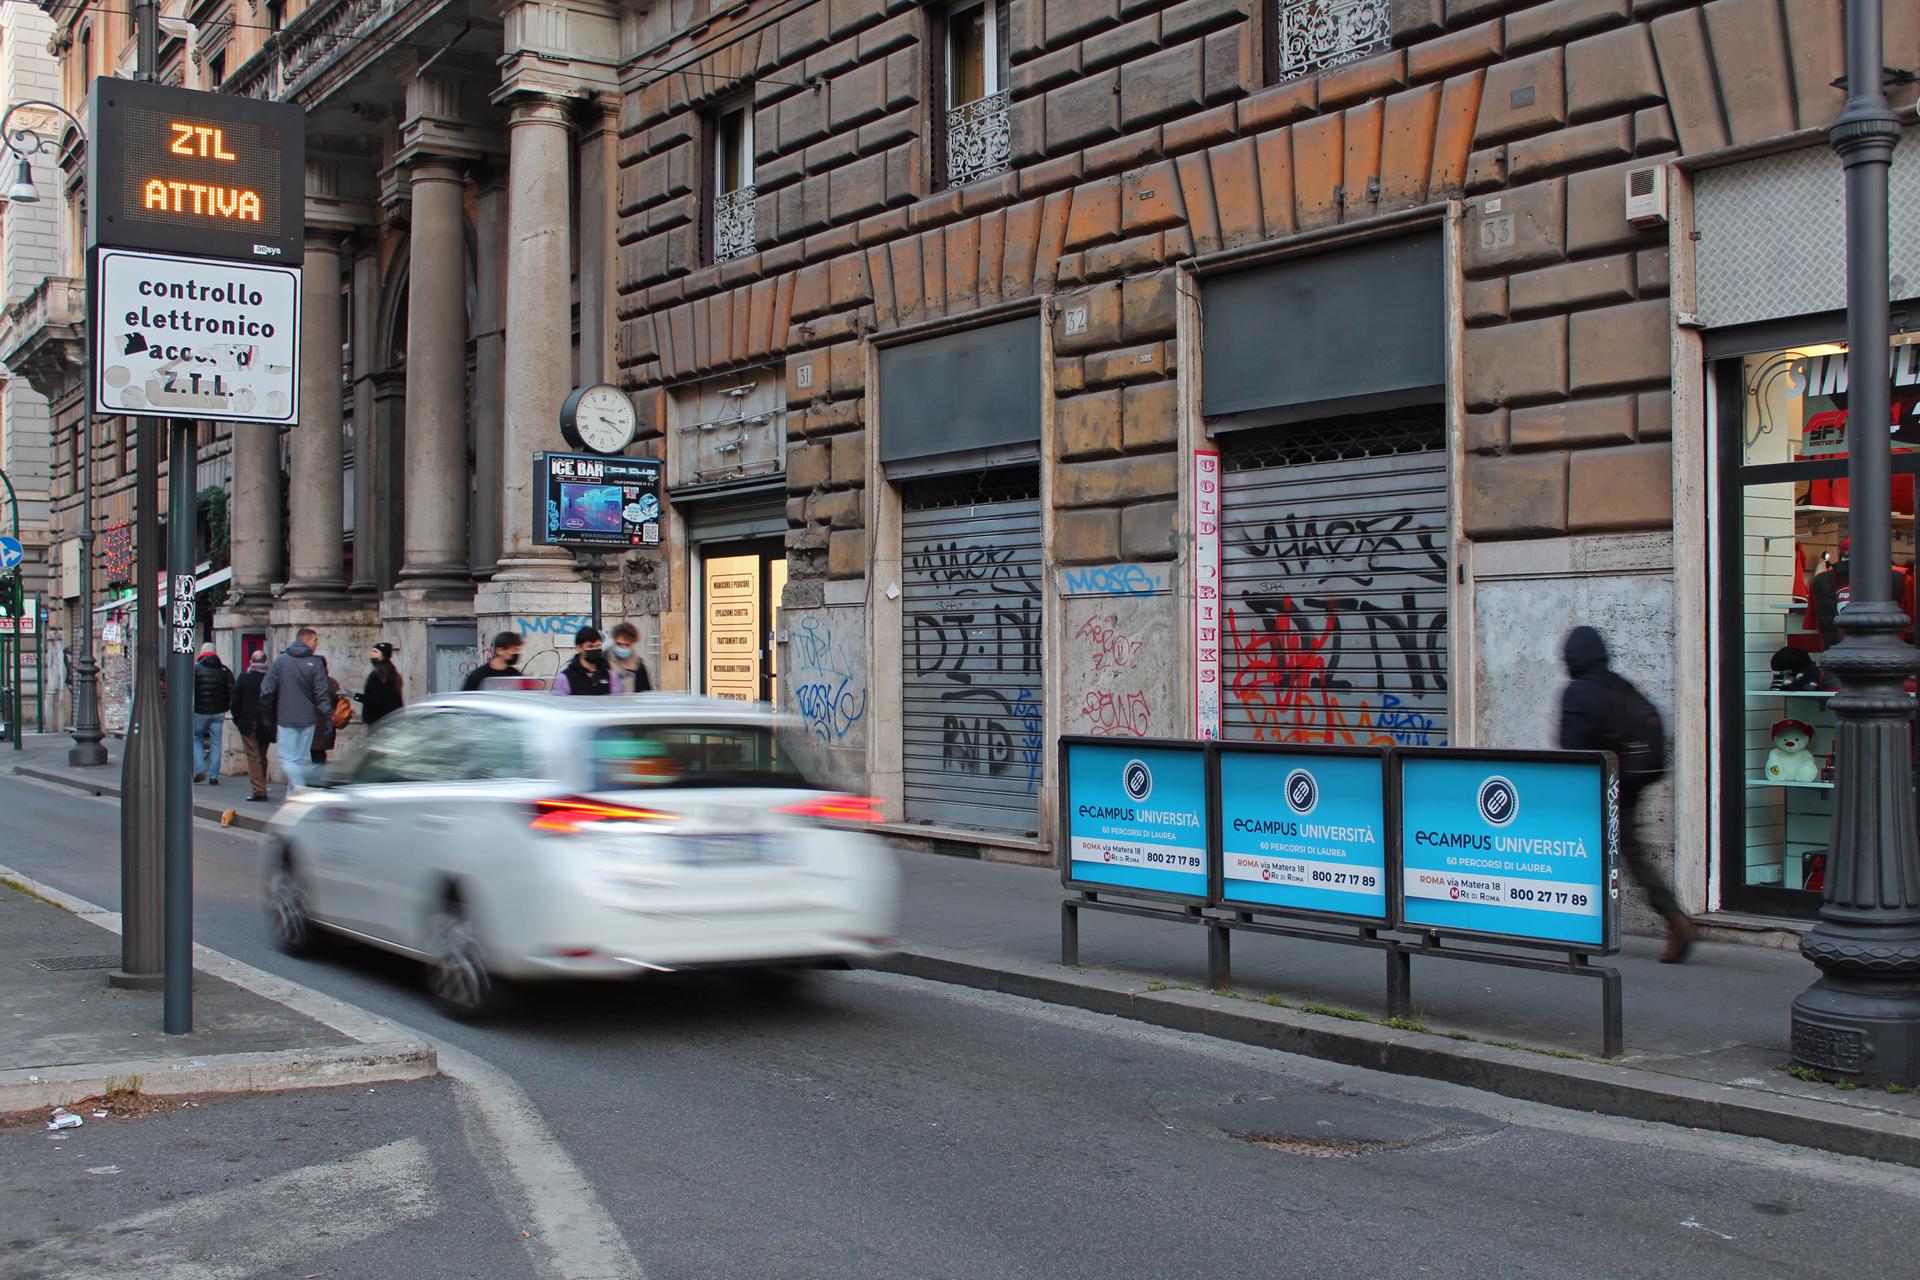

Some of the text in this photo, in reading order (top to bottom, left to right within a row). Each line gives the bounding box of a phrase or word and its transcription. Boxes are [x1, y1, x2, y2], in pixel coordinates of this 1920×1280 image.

[171, 123, 236, 161] ZTL
[144, 179, 261, 221] ATTIVA
[1484, 218, 1511, 246] 33
[138, 279, 263, 306] controllo
[125, 305, 275, 338] elettronico
[1067, 309, 1085, 331] 32
[163, 371, 234, 398] Z.T.L.
[799, 367, 809, 385] 31
[551, 458, 604, 477] ICE BAR
[1199, 459, 1217, 536] COLD
[1136, 810, 1200, 827] UNIVERSITÀ
[1111, 827, 1141, 836] PERCORSI
[1151, 831, 1176, 840] LAUREA
[1301, 824, 1375, 843] UNIVERSITÀ
[1271, 844, 1305, 853] PERCORSI
[1308, 846, 1314, 854] DI
[1317, 847, 1346, 857] LAUREA
[1496, 837, 1587, 858] UNIVERSITÀ
[1148, 853, 1200, 866] 800 27 17 89
[1238, 859, 1258, 867] ROMA
[1272, 863, 1296, 871] Matera
[1447, 857, 1552, 873] 60 PERCORSI DI LAUREA
[1312, 871, 1375, 886] 800 27 17 89
[1420, 876, 1500, 890] ROMA via Matera 18
[1510, 889, 1587, 906] 800 27 17 89
